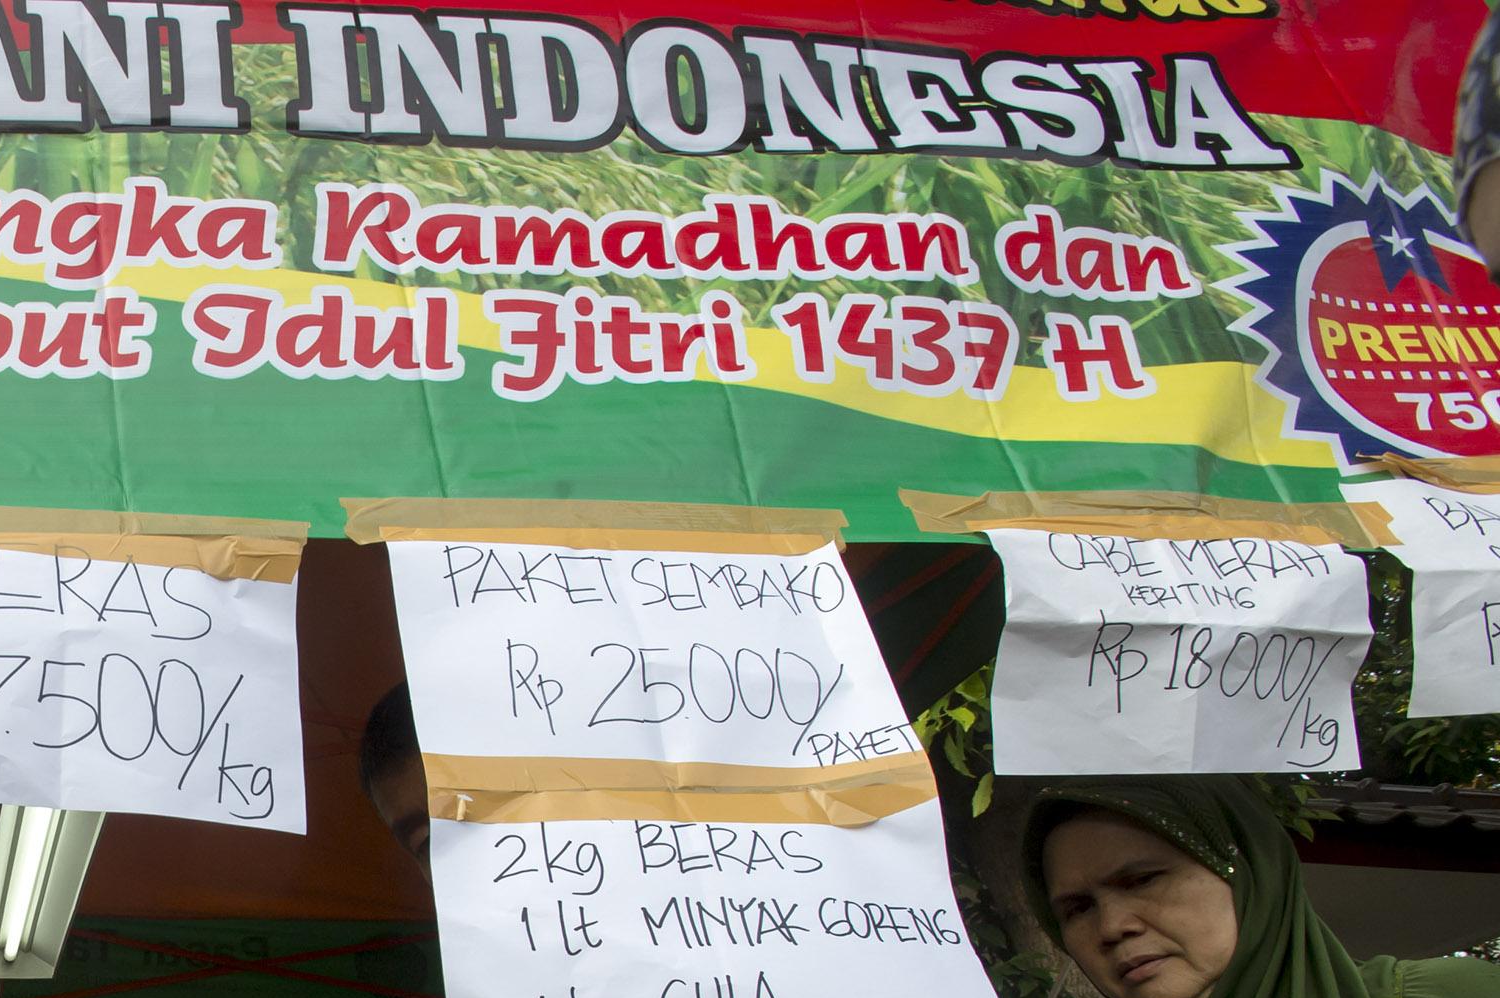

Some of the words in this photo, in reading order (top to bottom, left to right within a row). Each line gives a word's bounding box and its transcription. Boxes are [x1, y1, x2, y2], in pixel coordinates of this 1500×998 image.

[288, 8, 1292, 166] INDONESIA
[323, 190, 970, 275] Ramadhan
[1002, 213, 1191, 294] dan
[198, 293, 455, 371] Idul
[495, 296, 747, 393] Fitri
[782, 301, 1010, 391] 1437
[1053, 321, 1147, 394] H
[443, 545, 618, 607] PAKET
[630, 556, 846, 616] SEMBAKO
[1048, 532, 1162, 577] CABE
[1169, 537, 1332, 581] MERAH
[1121, 582, 1257, 609] KERITING
[507, 637, 564, 736] Rp
[1088, 608, 1148, 714] Rp
[635, 819, 823, 874] BERAS
[641, 896, 811, 949] MINYAK
[818, 897, 962, 946] GORENG
